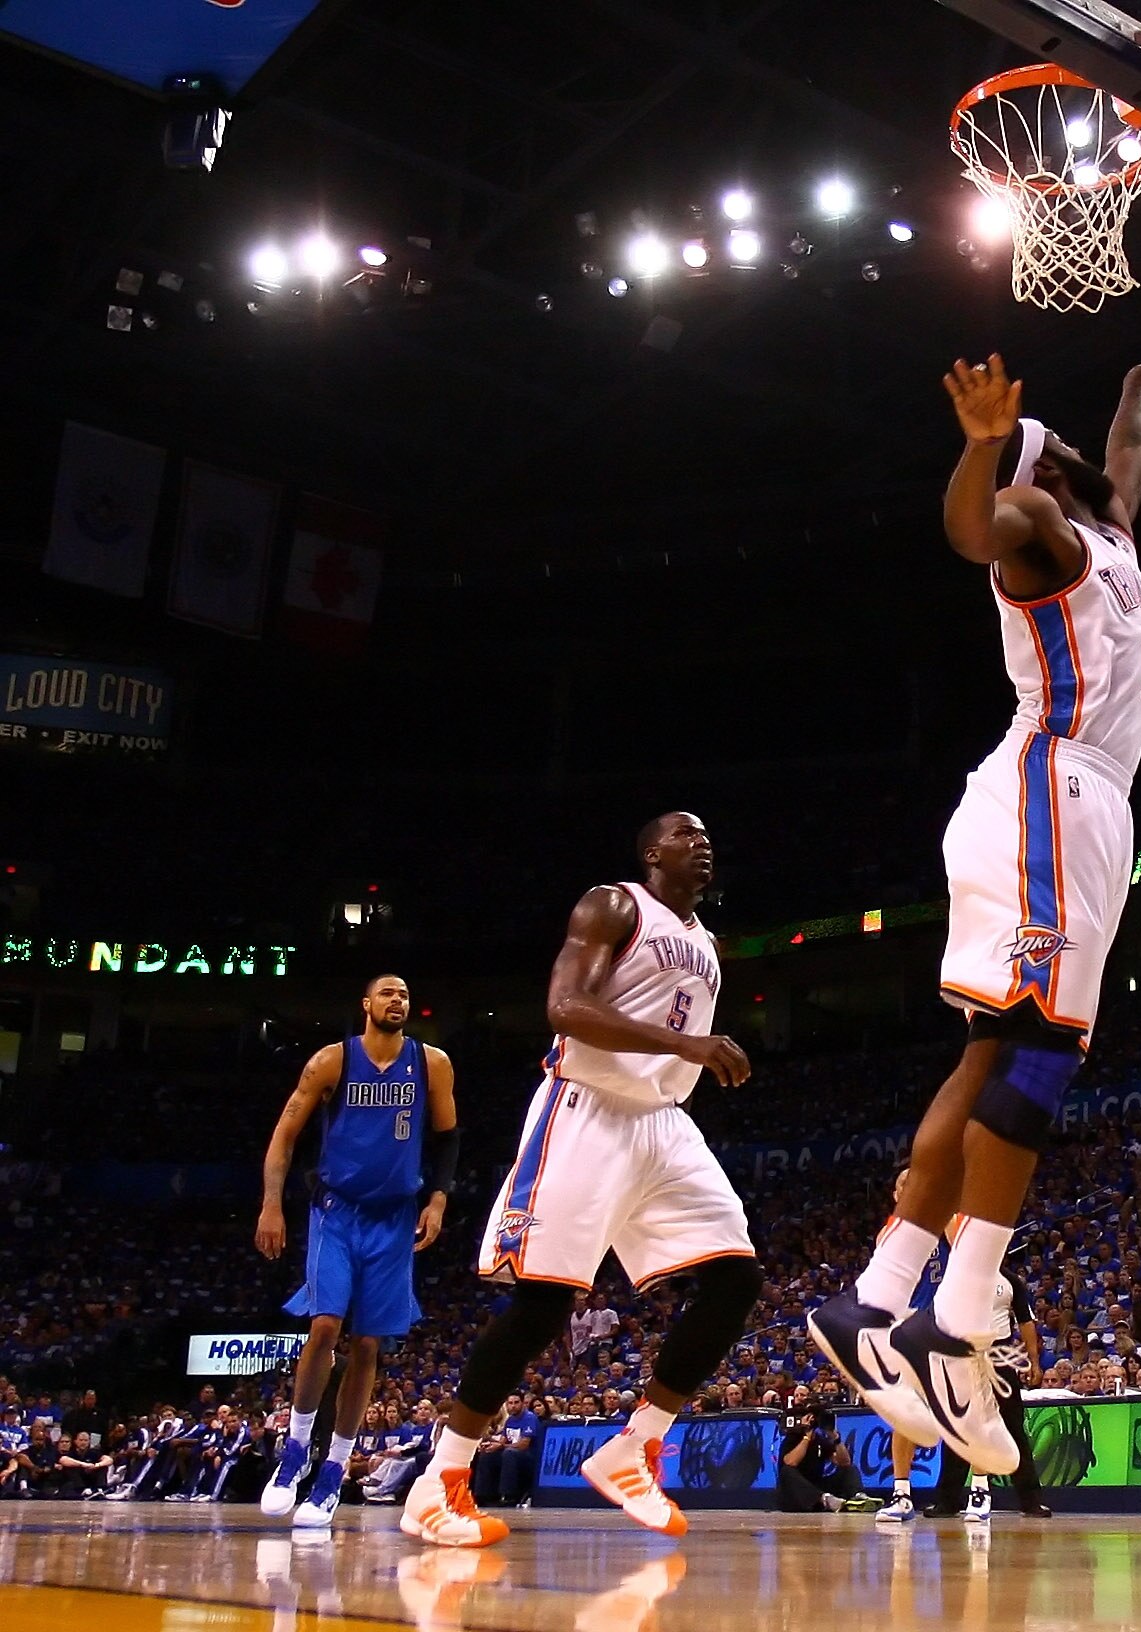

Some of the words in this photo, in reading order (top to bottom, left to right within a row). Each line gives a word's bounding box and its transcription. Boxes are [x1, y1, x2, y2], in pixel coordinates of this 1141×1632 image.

[5, 669, 88, 713] LOUD
[98, 673, 163, 725] CITY
[0, 723, 28, 739] ER
[62, 730, 113, 746] EXIT
[119, 735, 168, 752] NOW
[667, 986, 694, 1033] 5
[346, 1082, 415, 1107] DALLAS
[394, 1110, 411, 1140] 6
[208, 1339, 304, 1359] HOMELA
